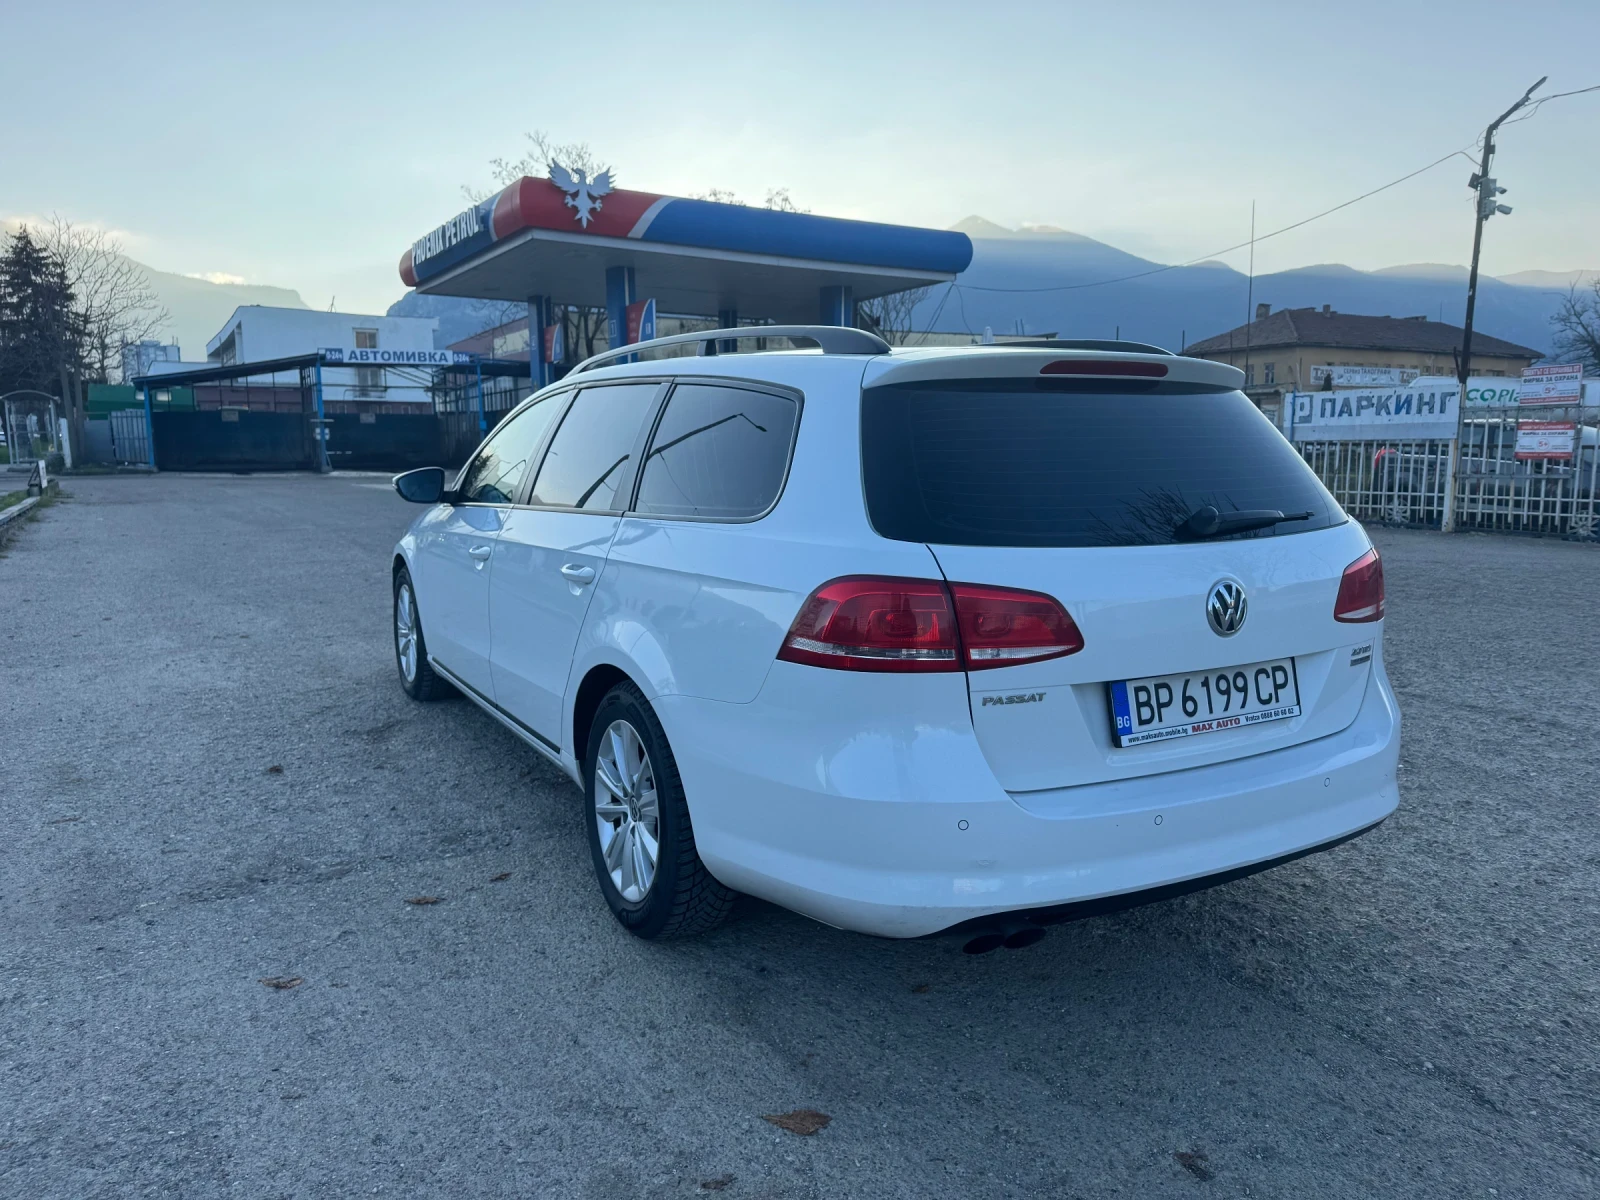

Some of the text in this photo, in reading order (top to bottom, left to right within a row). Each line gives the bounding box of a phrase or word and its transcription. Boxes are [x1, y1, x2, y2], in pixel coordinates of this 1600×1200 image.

[412, 205, 479, 267] PHOENIX PETROL
[348, 350, 449, 363] АВТОМИВКА
[1320, 392, 1457, 418] ПАРКИНГ
[982, 692, 1047, 706] PASSAT
[1133, 665, 1289, 726] BP 6199 CP
[1116, 715, 1131, 729] BG
[1128, 727, 1188, 743] www.maksauto.mobile.bg
[1191, 722, 1214, 733] MAX
[1216, 717, 1241, 729] AUTO
